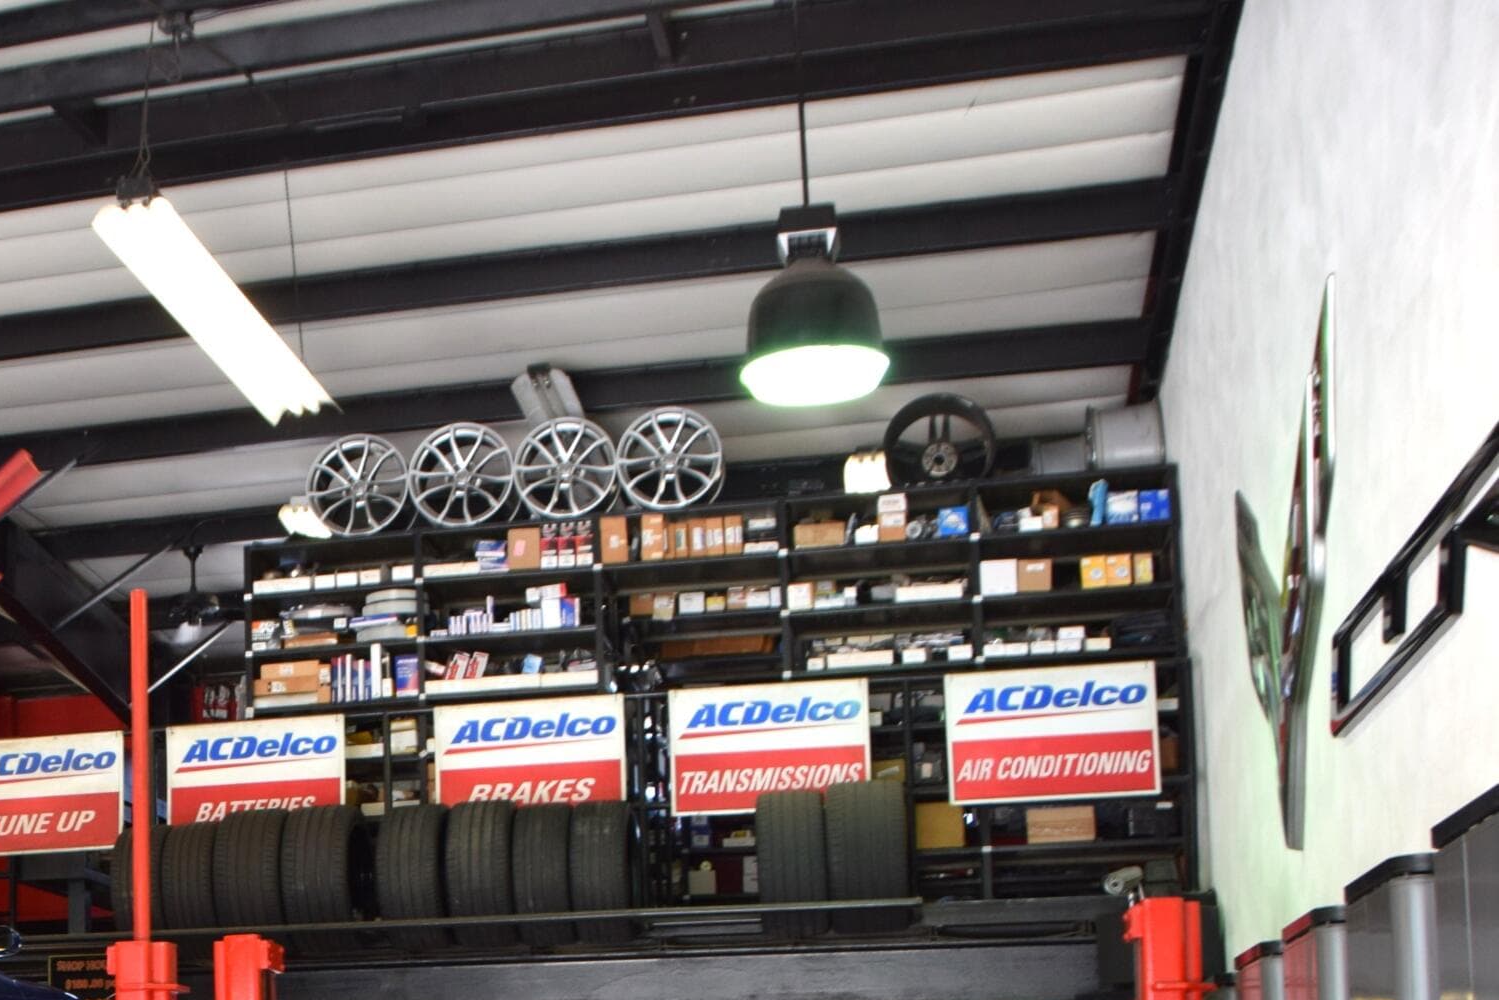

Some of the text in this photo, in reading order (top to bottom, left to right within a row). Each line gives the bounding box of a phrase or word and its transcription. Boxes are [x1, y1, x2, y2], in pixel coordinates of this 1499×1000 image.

[686, 696, 861, 729] ACDelco
[963, 680, 1148, 715] ACDelco
[451, 712, 617, 744] ACDelco
[182, 732, 337, 763] ACDelco
[679, 762, 863, 795] TRANSMISSIONS
[956, 749, 1151, 783] AIR CONDITIONING
[467, 777, 596, 804] BRAKES
[56, 810, 96, 833] UP
